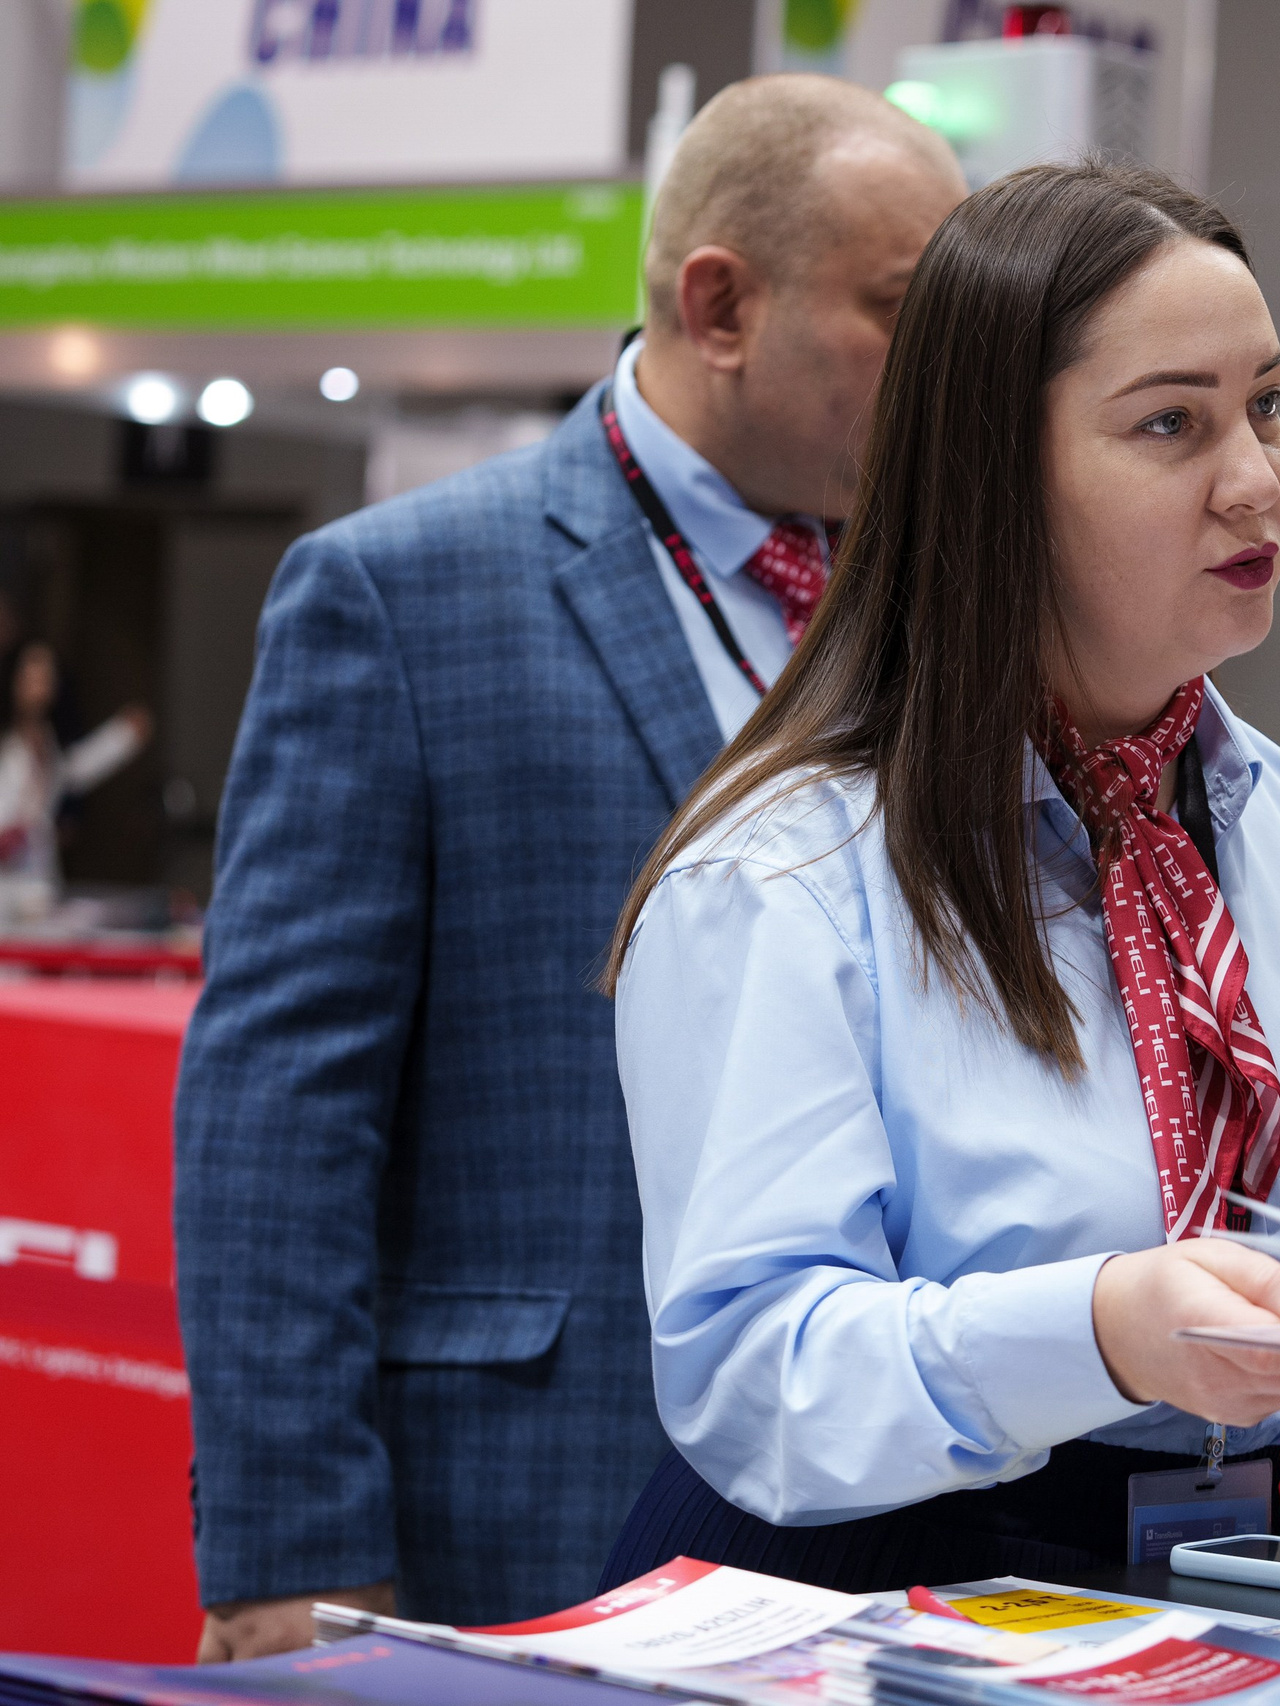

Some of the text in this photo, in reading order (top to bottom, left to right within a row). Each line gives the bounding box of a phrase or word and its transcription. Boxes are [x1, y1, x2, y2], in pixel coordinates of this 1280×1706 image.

[1154, 843, 1194, 899] HELI
[1132, 891, 1157, 950] HELI
[1144, 882, 1180, 940] HELI
[1124, 935, 1152, 996] HELI
[1121, 986, 1144, 1049] HELI
[1155, 979, 1180, 1040] HELI
[1149, 1024, 1173, 1087] HELI
[1142, 1075, 1163, 1139] HELI
[1178, 1071, 1197, 1136] HELI
[1169, 1118, 1191, 1183] HELI
[1160, 1169, 1179, 1232] HEL
